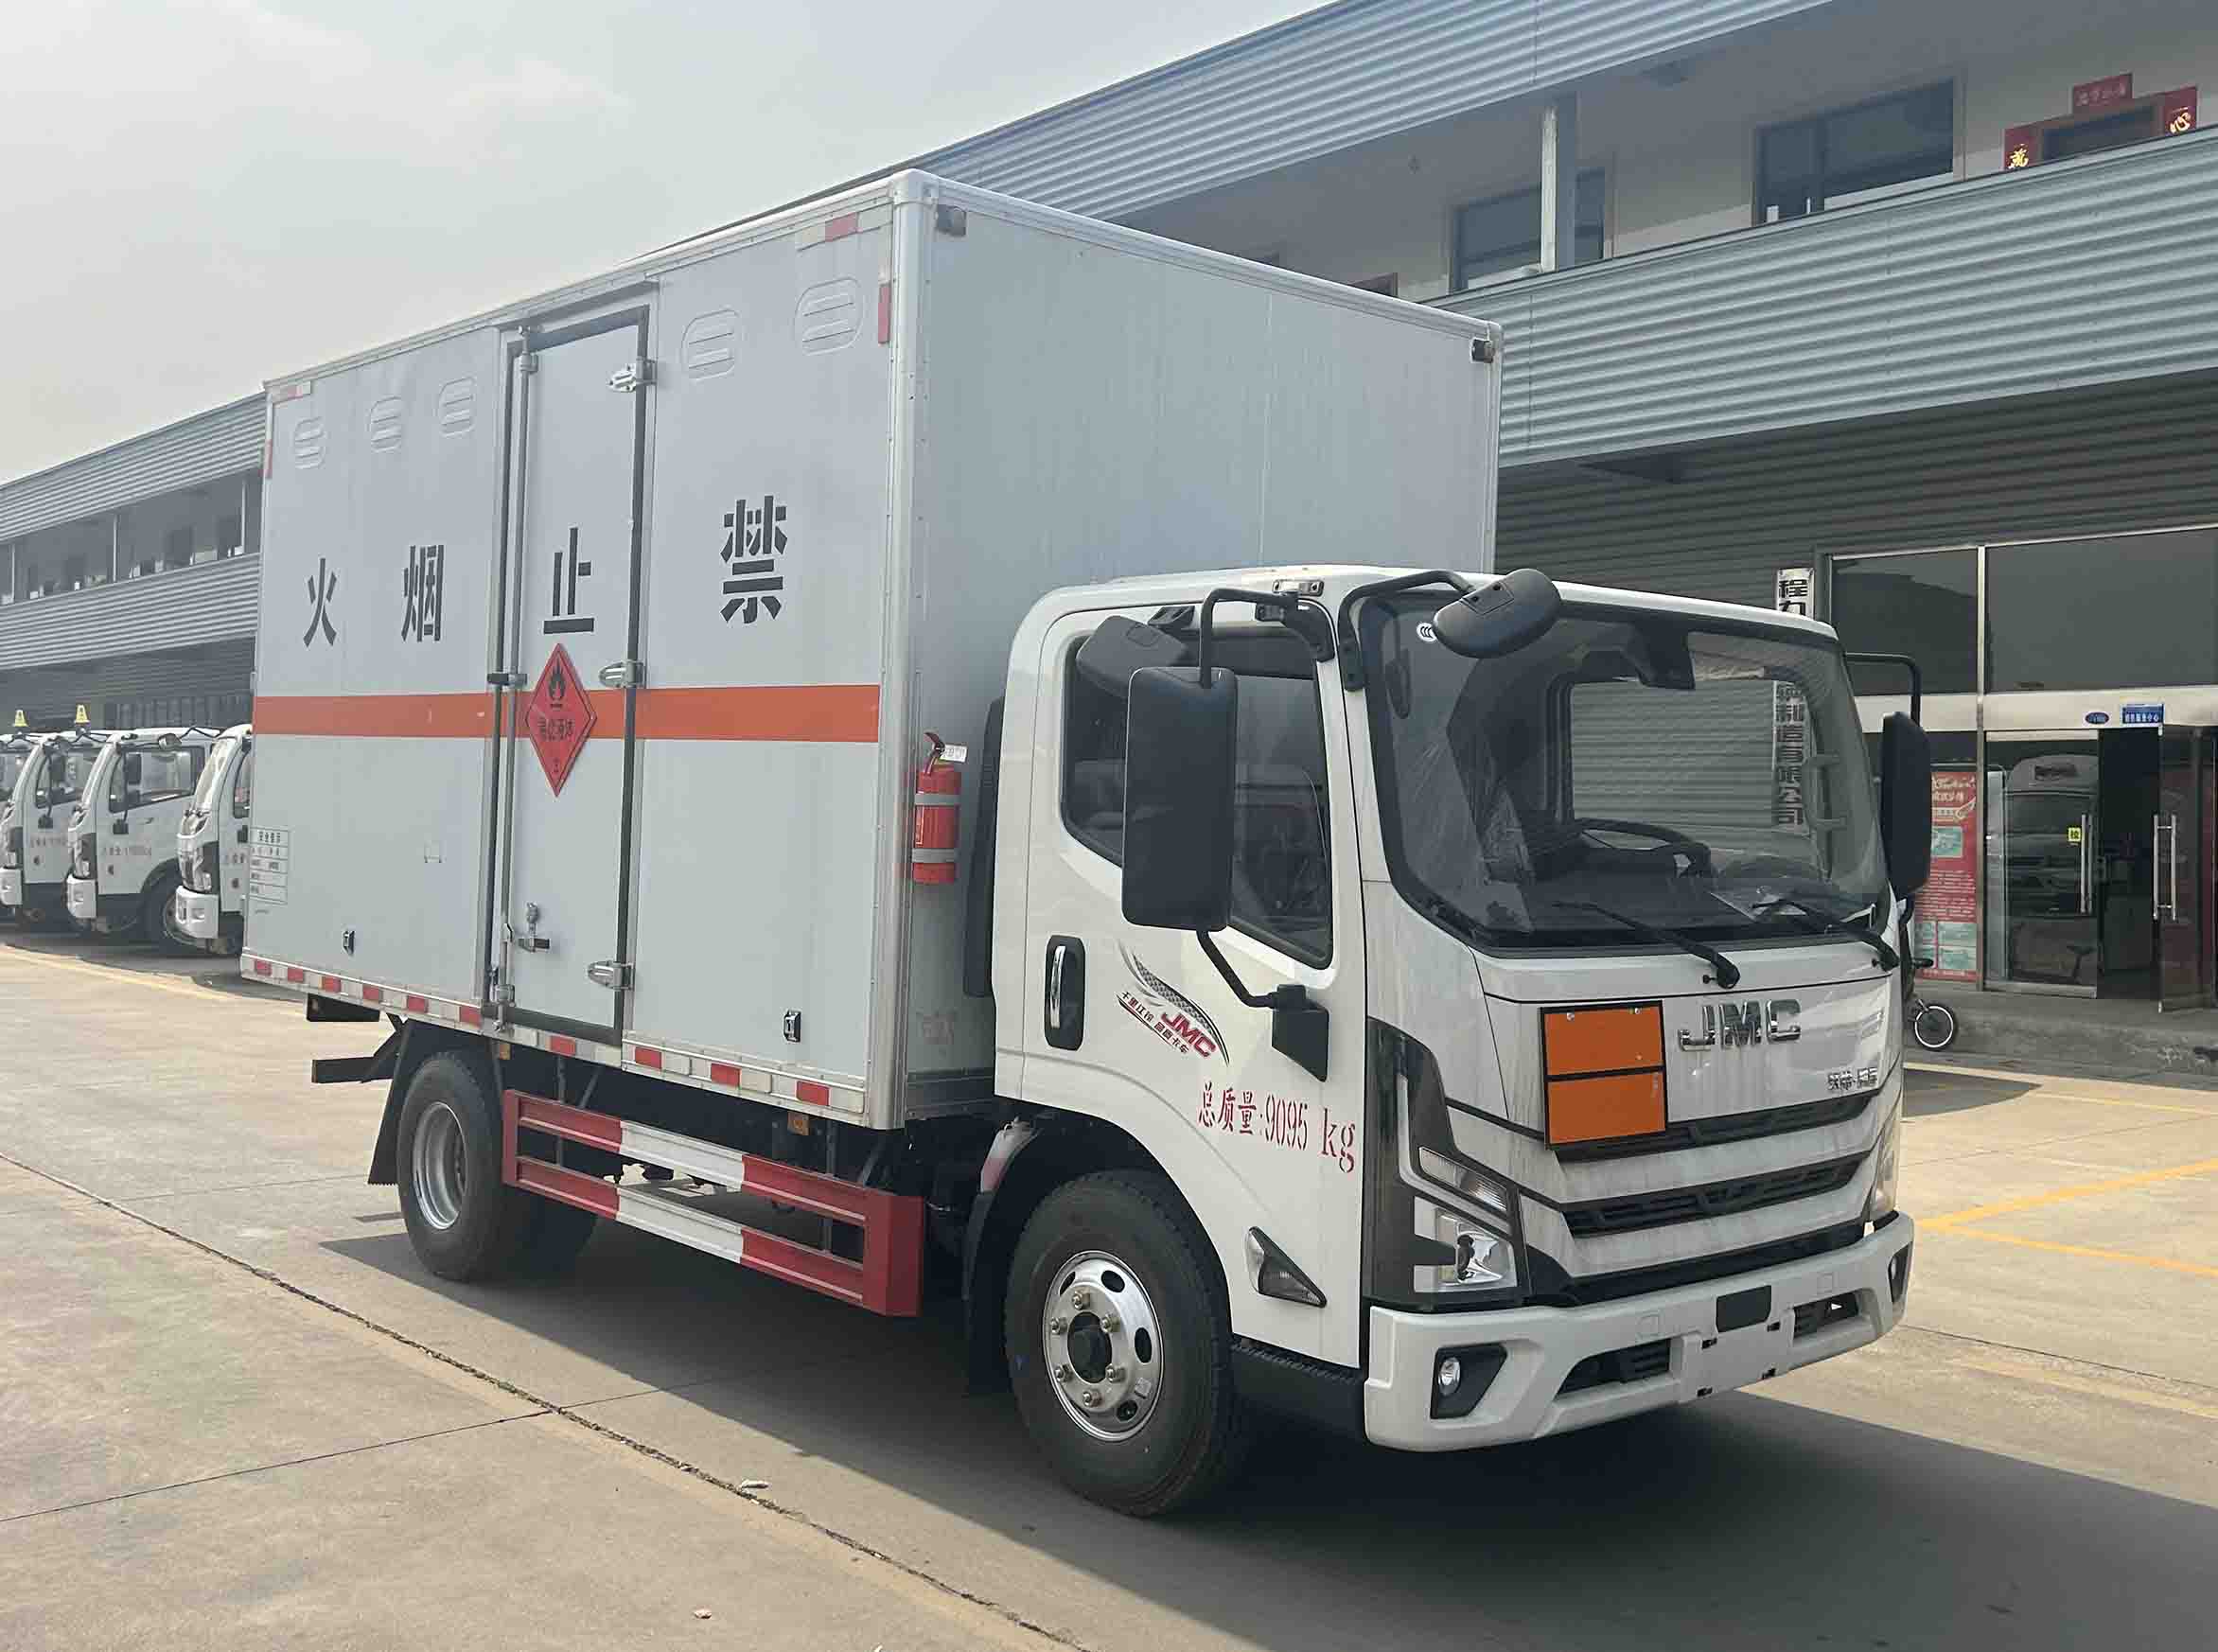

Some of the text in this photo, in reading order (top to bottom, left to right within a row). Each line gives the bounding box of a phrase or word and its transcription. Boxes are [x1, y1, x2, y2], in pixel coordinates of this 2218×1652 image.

[303, 495, 788, 647] 禁 止 烟 火
[1160, 1011, 1217, 1058] JMC
[1679, 999, 1802, 1052] JMC
[1321, 1107, 1356, 1174] kg
